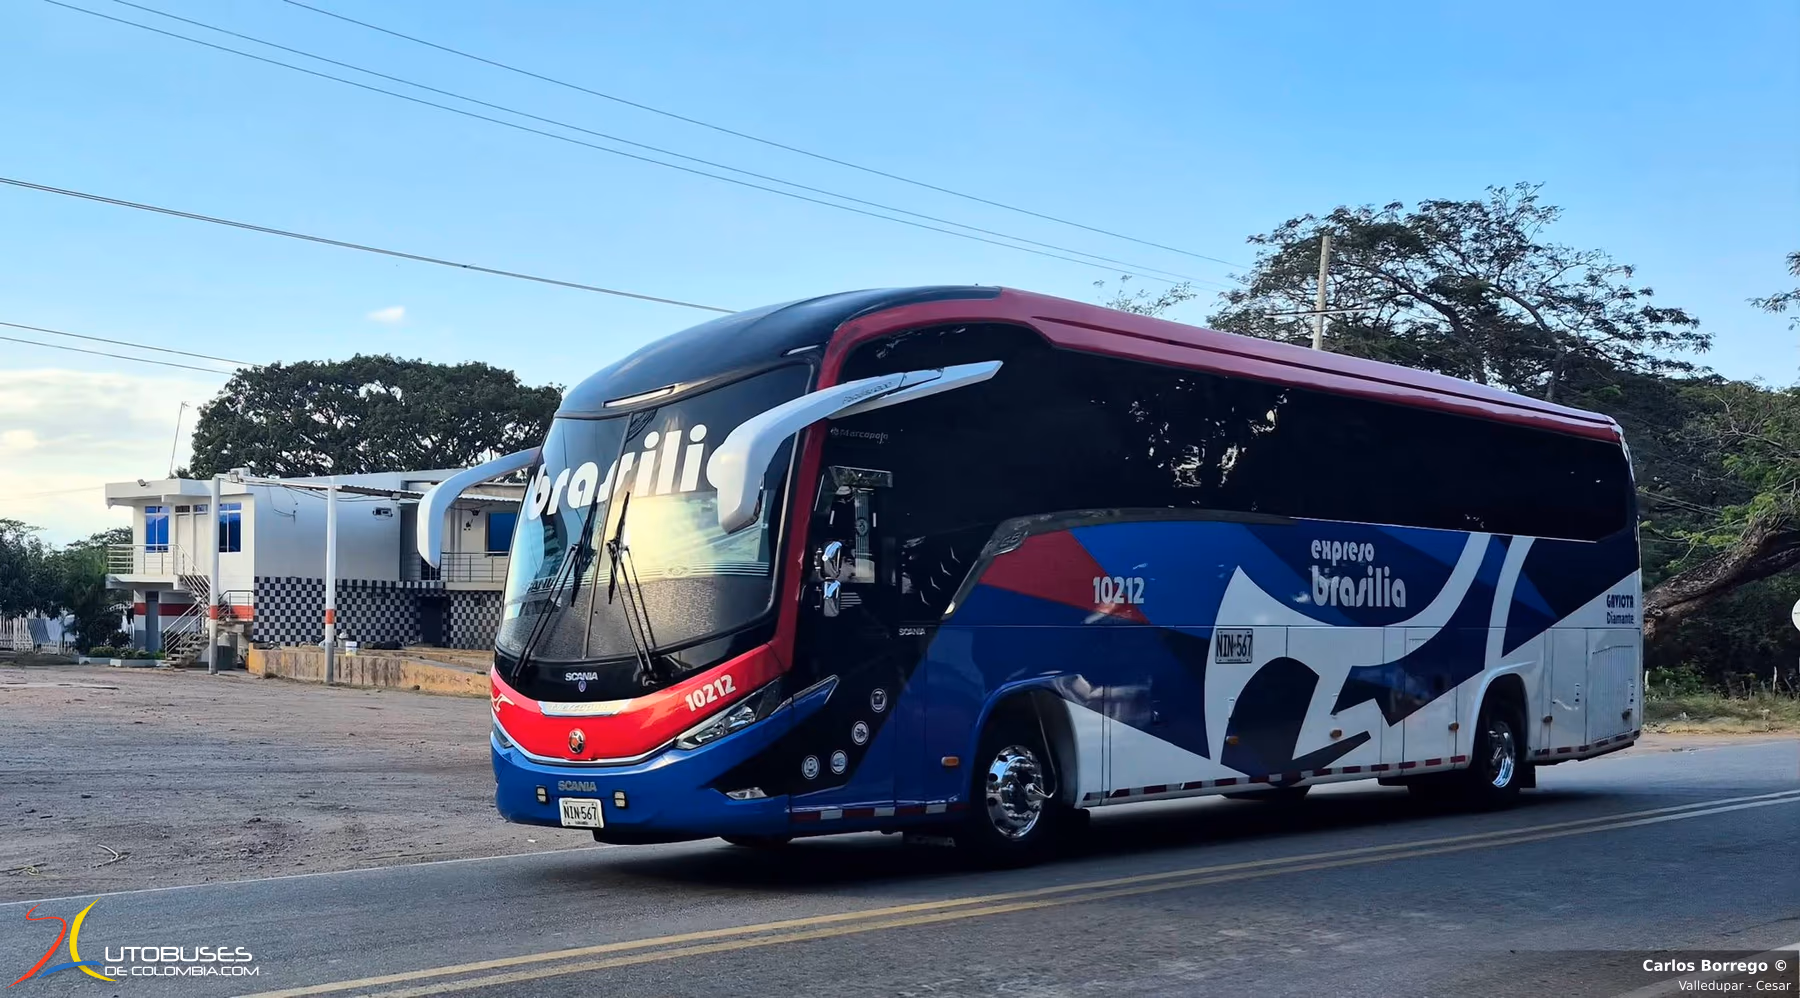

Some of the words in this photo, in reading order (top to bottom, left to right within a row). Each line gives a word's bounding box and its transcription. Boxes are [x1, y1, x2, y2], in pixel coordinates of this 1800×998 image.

[1311, 539, 1375, 566] expreso
[1093, 576, 1145, 604] 10212
[1312, 565, 1406, 608] brasilia
[1606, 611, 1634, 624] Diamante
[565, 672, 599, 681] SCANIA
[685, 674, 737, 712] 10212
[558, 780, 597, 792] SCANIA
